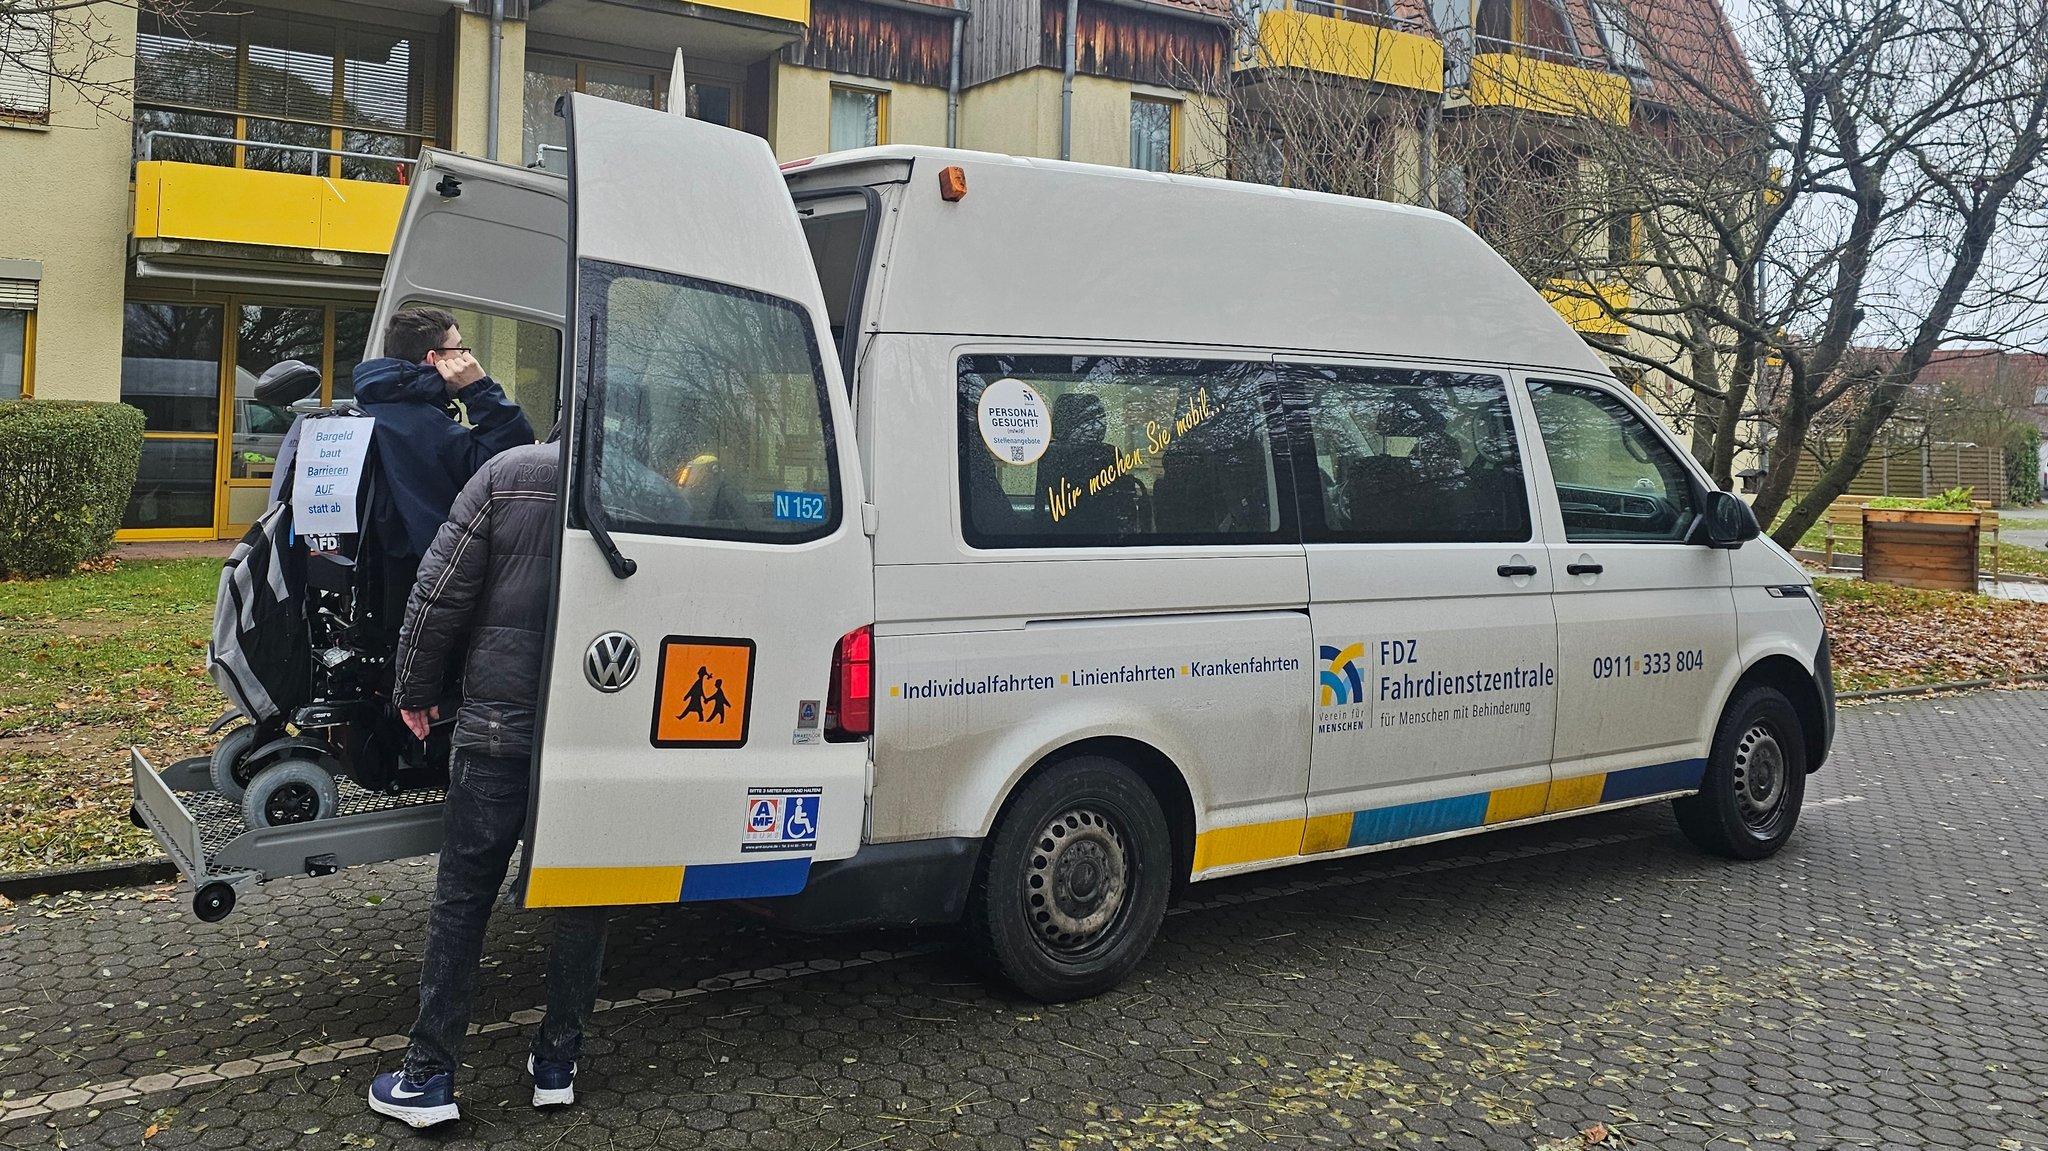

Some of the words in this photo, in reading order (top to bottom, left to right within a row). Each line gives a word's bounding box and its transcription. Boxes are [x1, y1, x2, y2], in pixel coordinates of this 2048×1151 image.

[989, 408, 1039, 417] PERSONAL
[992, 418, 1039, 427] GESUCHT!
[315, 430, 354, 443] Bargeld
[993, 437, 1041, 445] Stellenangebote
[320, 448, 342, 458] baut
[1049, 477, 1082, 522] Wir
[1089, 447, 1143, 495] machen
[1146, 421, 1171, 454] Sie
[1176, 387, 1225, 436] mobil...
[307, 465, 349, 477] Barrieren
[518, 463, 559, 483] RO
[315, 484, 334, 495] AUF
[308, 503, 329, 514] statt
[330, 502, 341, 513] ab
[776, 494, 789, 517] N
[793, 496, 823, 519] 152
[1380, 639, 1418, 666] FDZ
[1593, 655, 1631, 679] 0911
[1643, 652, 1671, 675] 333
[1676, 649, 1704, 672] 804
[903, 674, 1055, 700] Individualfahrten
[1072, 664, 1176, 687] Linienfahrten
[1191, 656, 1299, 678] Krankenfahrten
[1380, 662, 1554, 701] Fahrdienstzentrale
[1318, 710, 1347, 721] Verein
[1351, 707, 1364, 718] für
[1380, 711, 1396, 728] für
[1399, 707, 1449, 725] Menschen
[1453, 705, 1469, 720] mit
[1472, 700, 1531, 718] Behinderung
[1318, 721, 1364, 734] MENSCHEN
